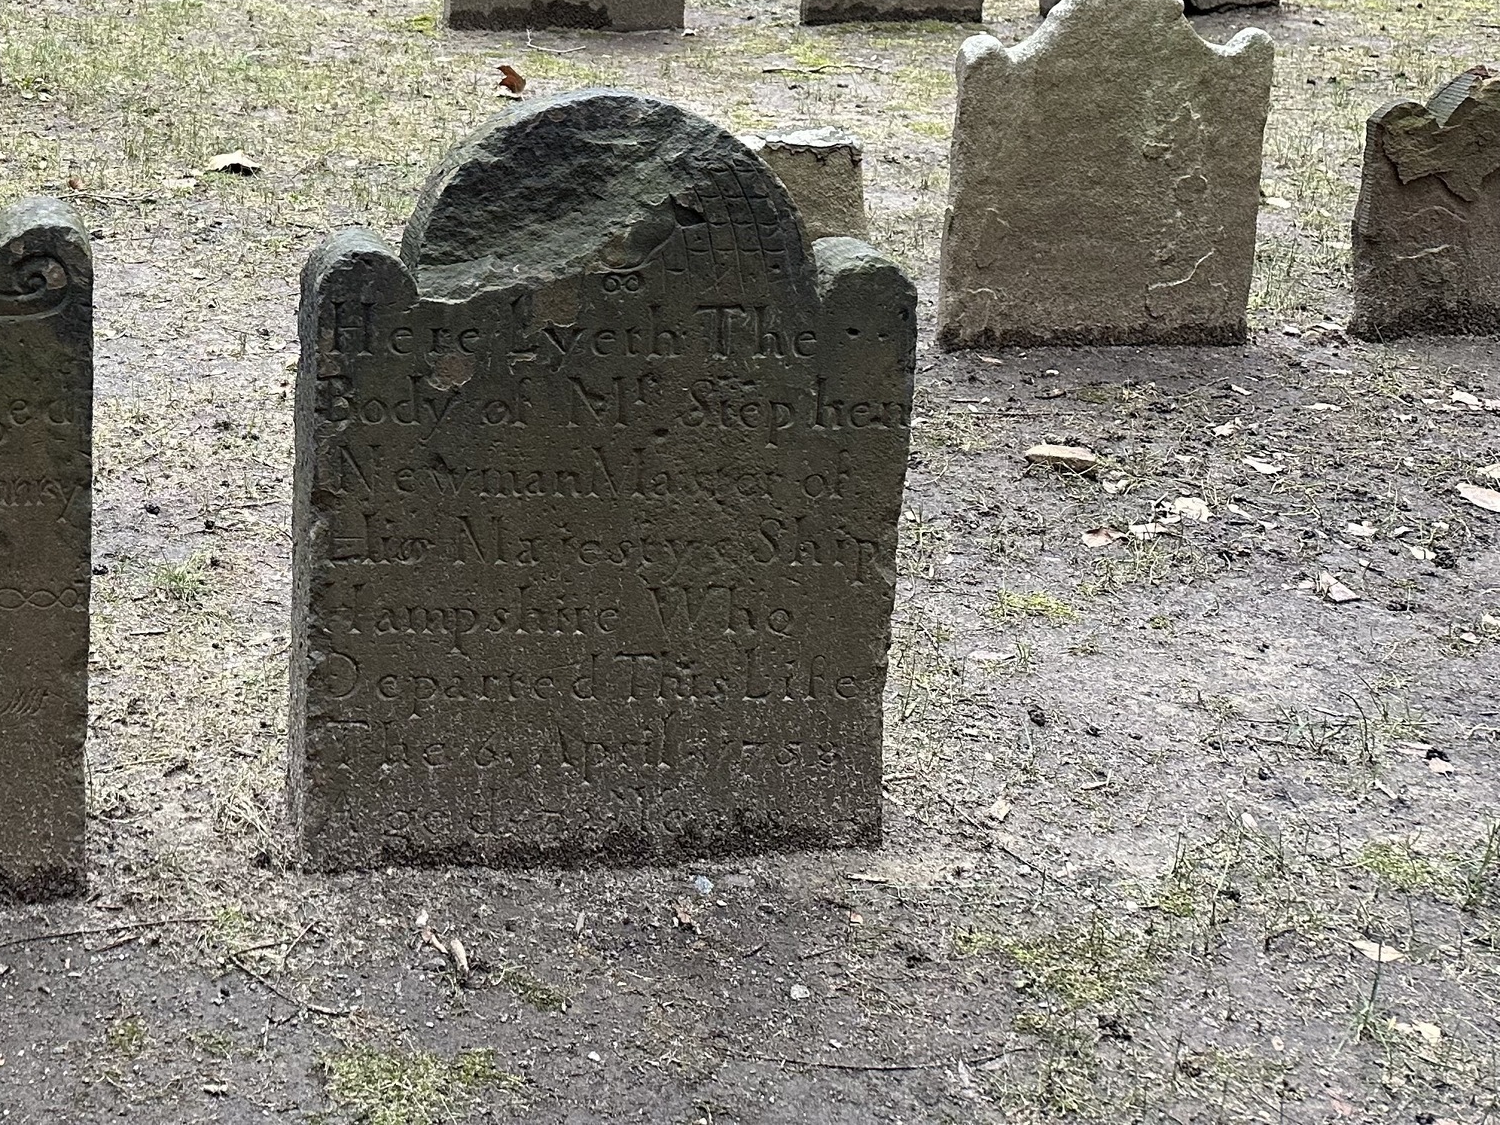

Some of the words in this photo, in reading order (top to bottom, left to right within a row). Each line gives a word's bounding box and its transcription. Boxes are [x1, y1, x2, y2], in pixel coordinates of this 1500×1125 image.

[329, 299, 480, 357] Here
[693, 305, 819, 361] The
[316, 373, 462, 449] Body
[482, 377, 532, 432] of
[799, 451, 851, 502] of
[748, 517, 882, 589] Ship
[308, 651, 602, 720] Departed
[743, 649, 857, 704] Life
